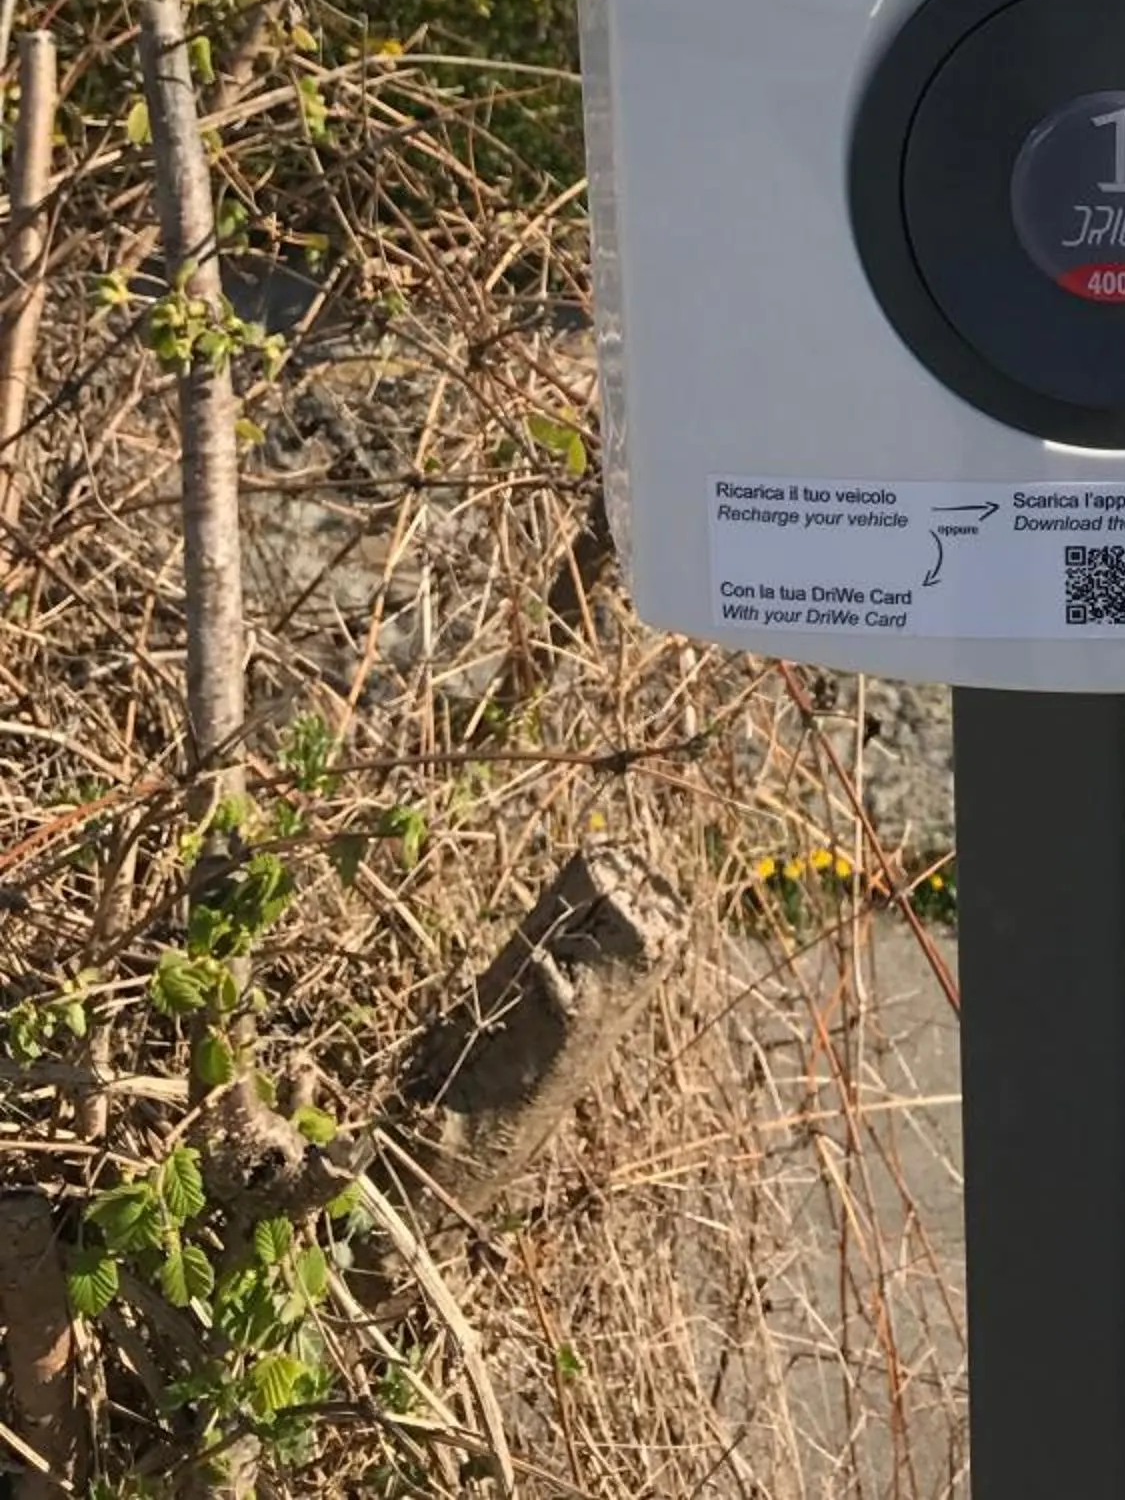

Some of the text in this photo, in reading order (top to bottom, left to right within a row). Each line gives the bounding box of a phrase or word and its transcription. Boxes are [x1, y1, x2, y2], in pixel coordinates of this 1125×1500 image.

[716, 482, 897, 505] Ricarica il tuo veicolo
[1013, 491, 1079, 509] Scarica
[717, 504, 909, 528] Recharge your vehicle
[1013, 515, 1102, 531] Download
[937, 524, 979, 536] oppure
[719, 581, 912, 605] Con la tua DriWe Card
[722, 604, 907, 627] With your DriWe Card
